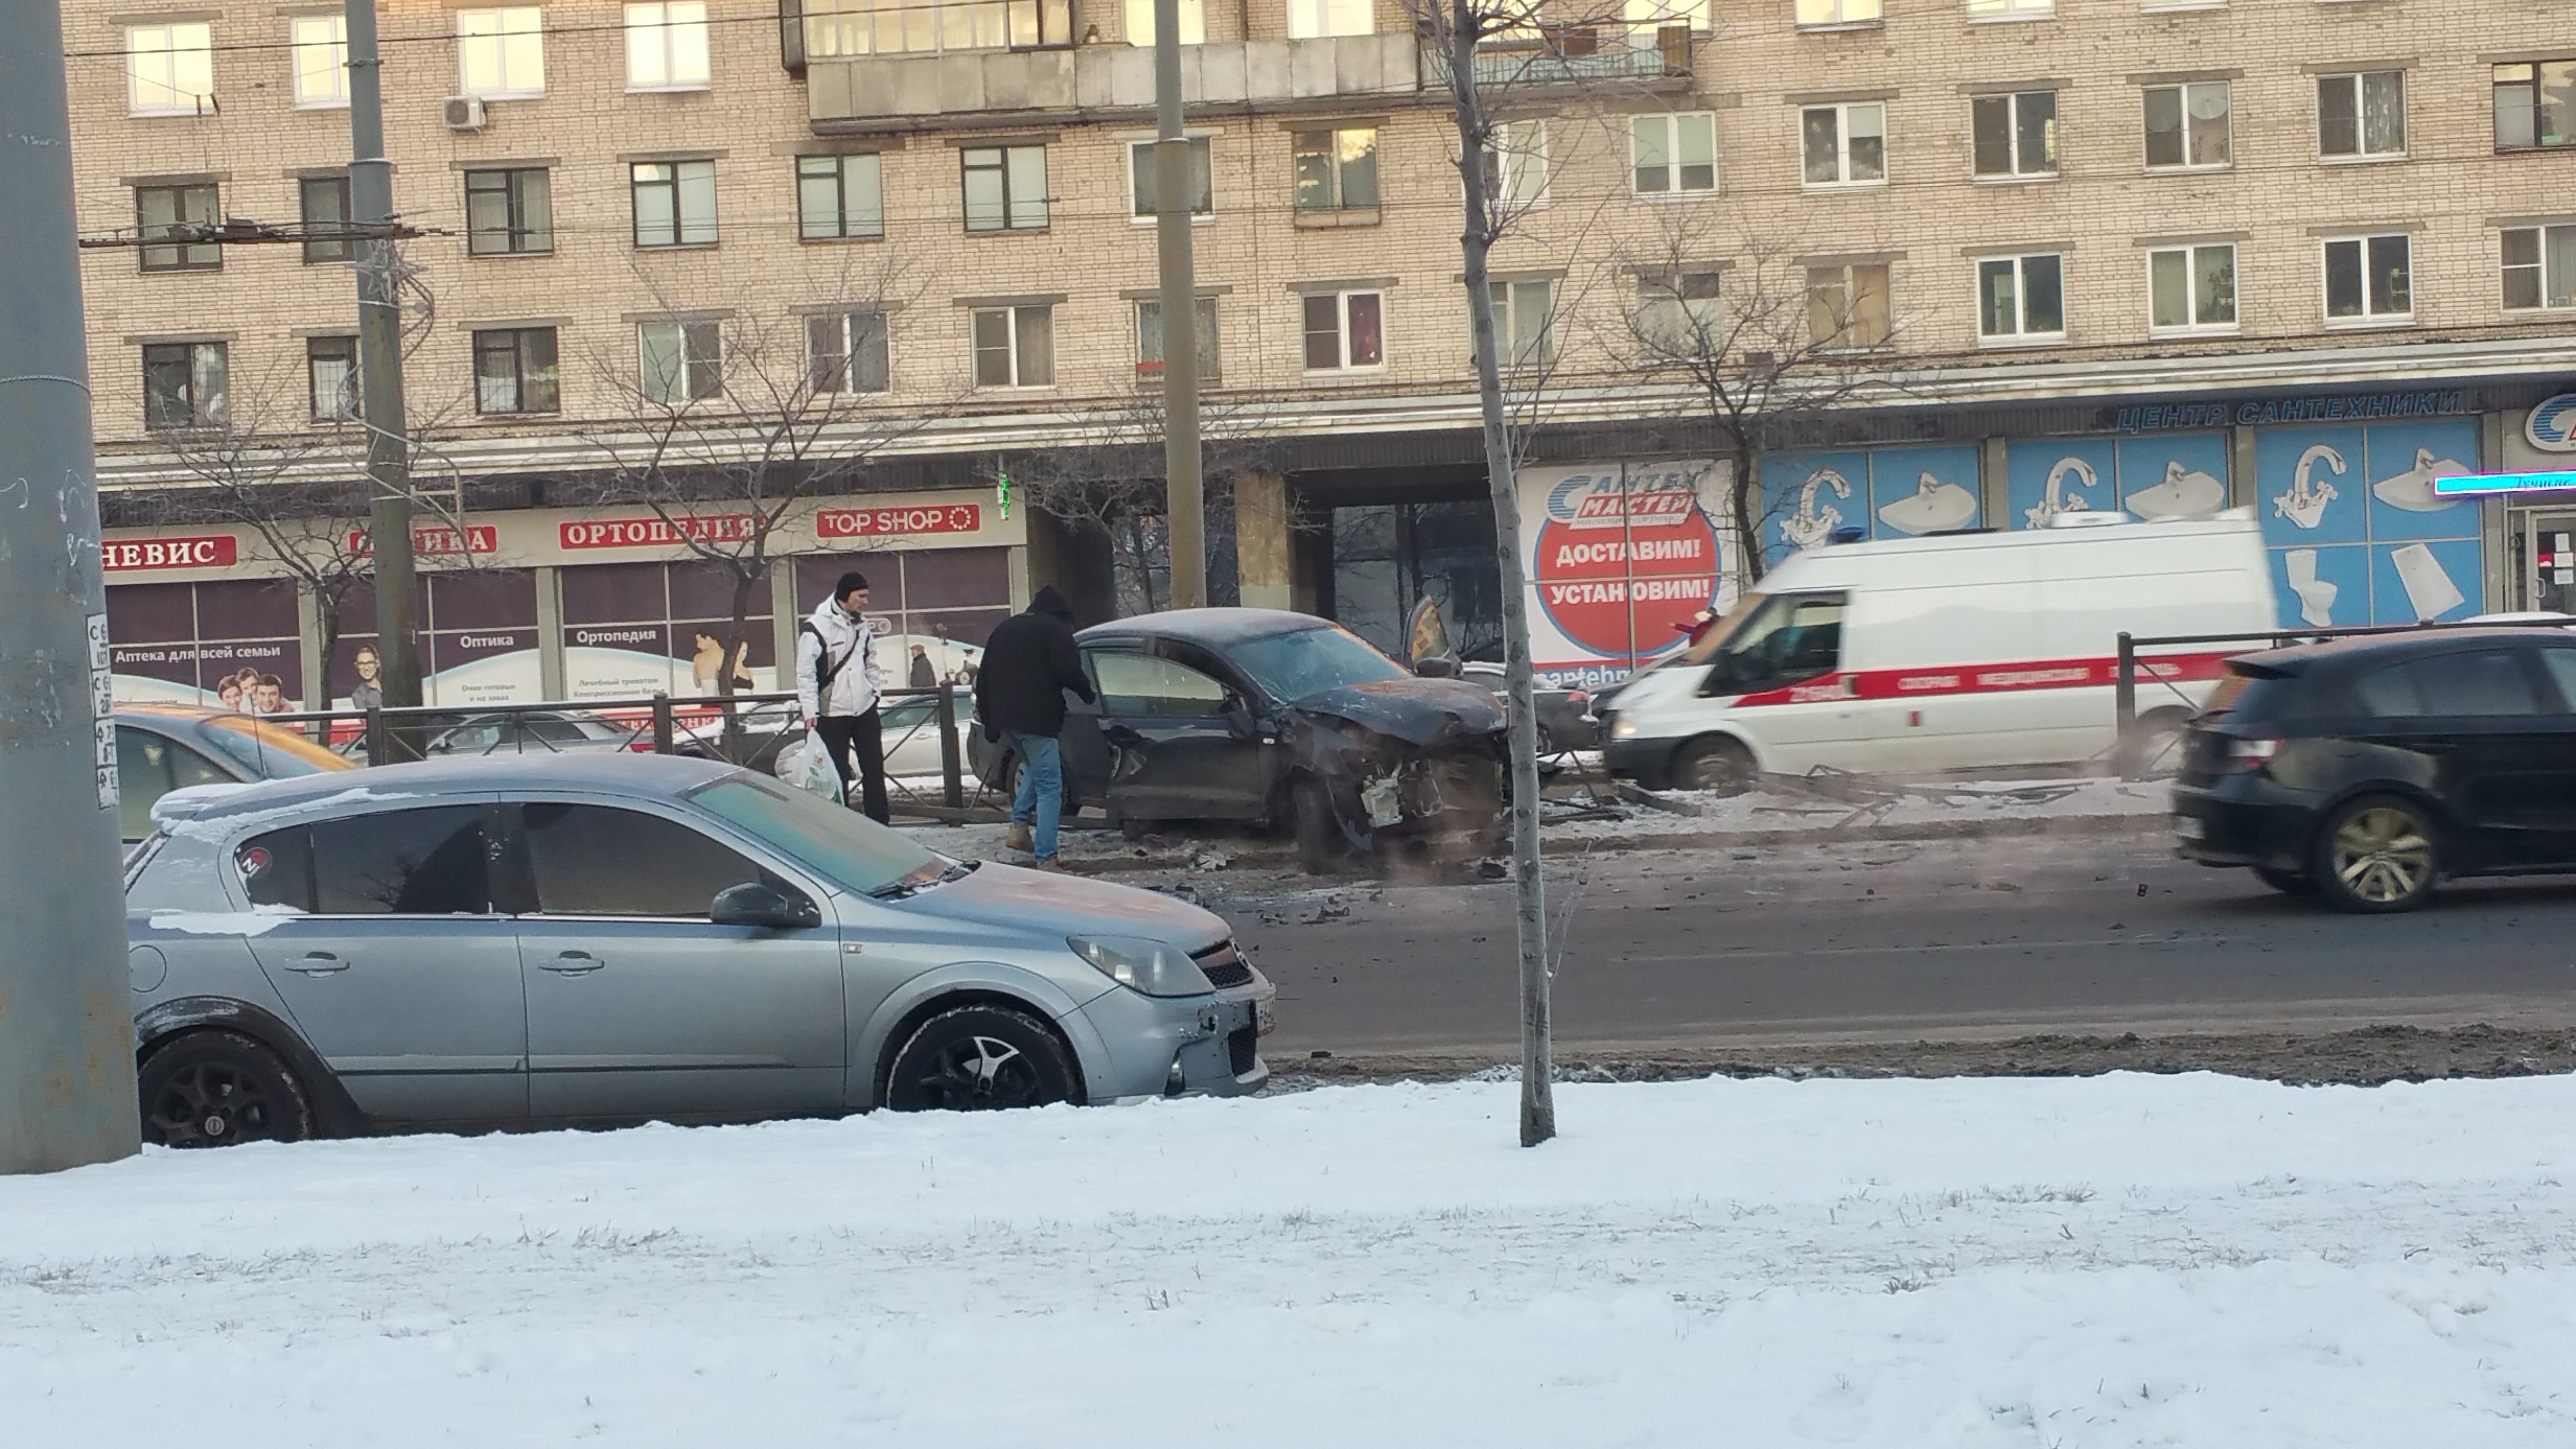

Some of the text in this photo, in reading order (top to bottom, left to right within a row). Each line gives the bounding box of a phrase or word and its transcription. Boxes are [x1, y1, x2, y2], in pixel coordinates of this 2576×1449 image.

[2117, 390, 2463, 435] ЦЕНТР САНТЕХНИКИ
[1580, 495, 1689, 516] МАСТЕР
[568, 518, 755, 544] ОРТОПЕДИЯ
[825, 510, 943, 533] TOP SHOP
[357, 530, 488, 552] ОИКА
[1556, 538, 1701, 568] ДОСТАВИМ!
[1551, 579, 1709, 605] УСТАНОВИМ!
[460, 635, 514, 648] Оптика
[577, 630, 657, 645] Ортопедия
[115, 650, 165, 663] Аптека
[169, 650, 195, 662] для
[200, 645, 232, 659] всей
[236, 646, 281, 658] семьи
